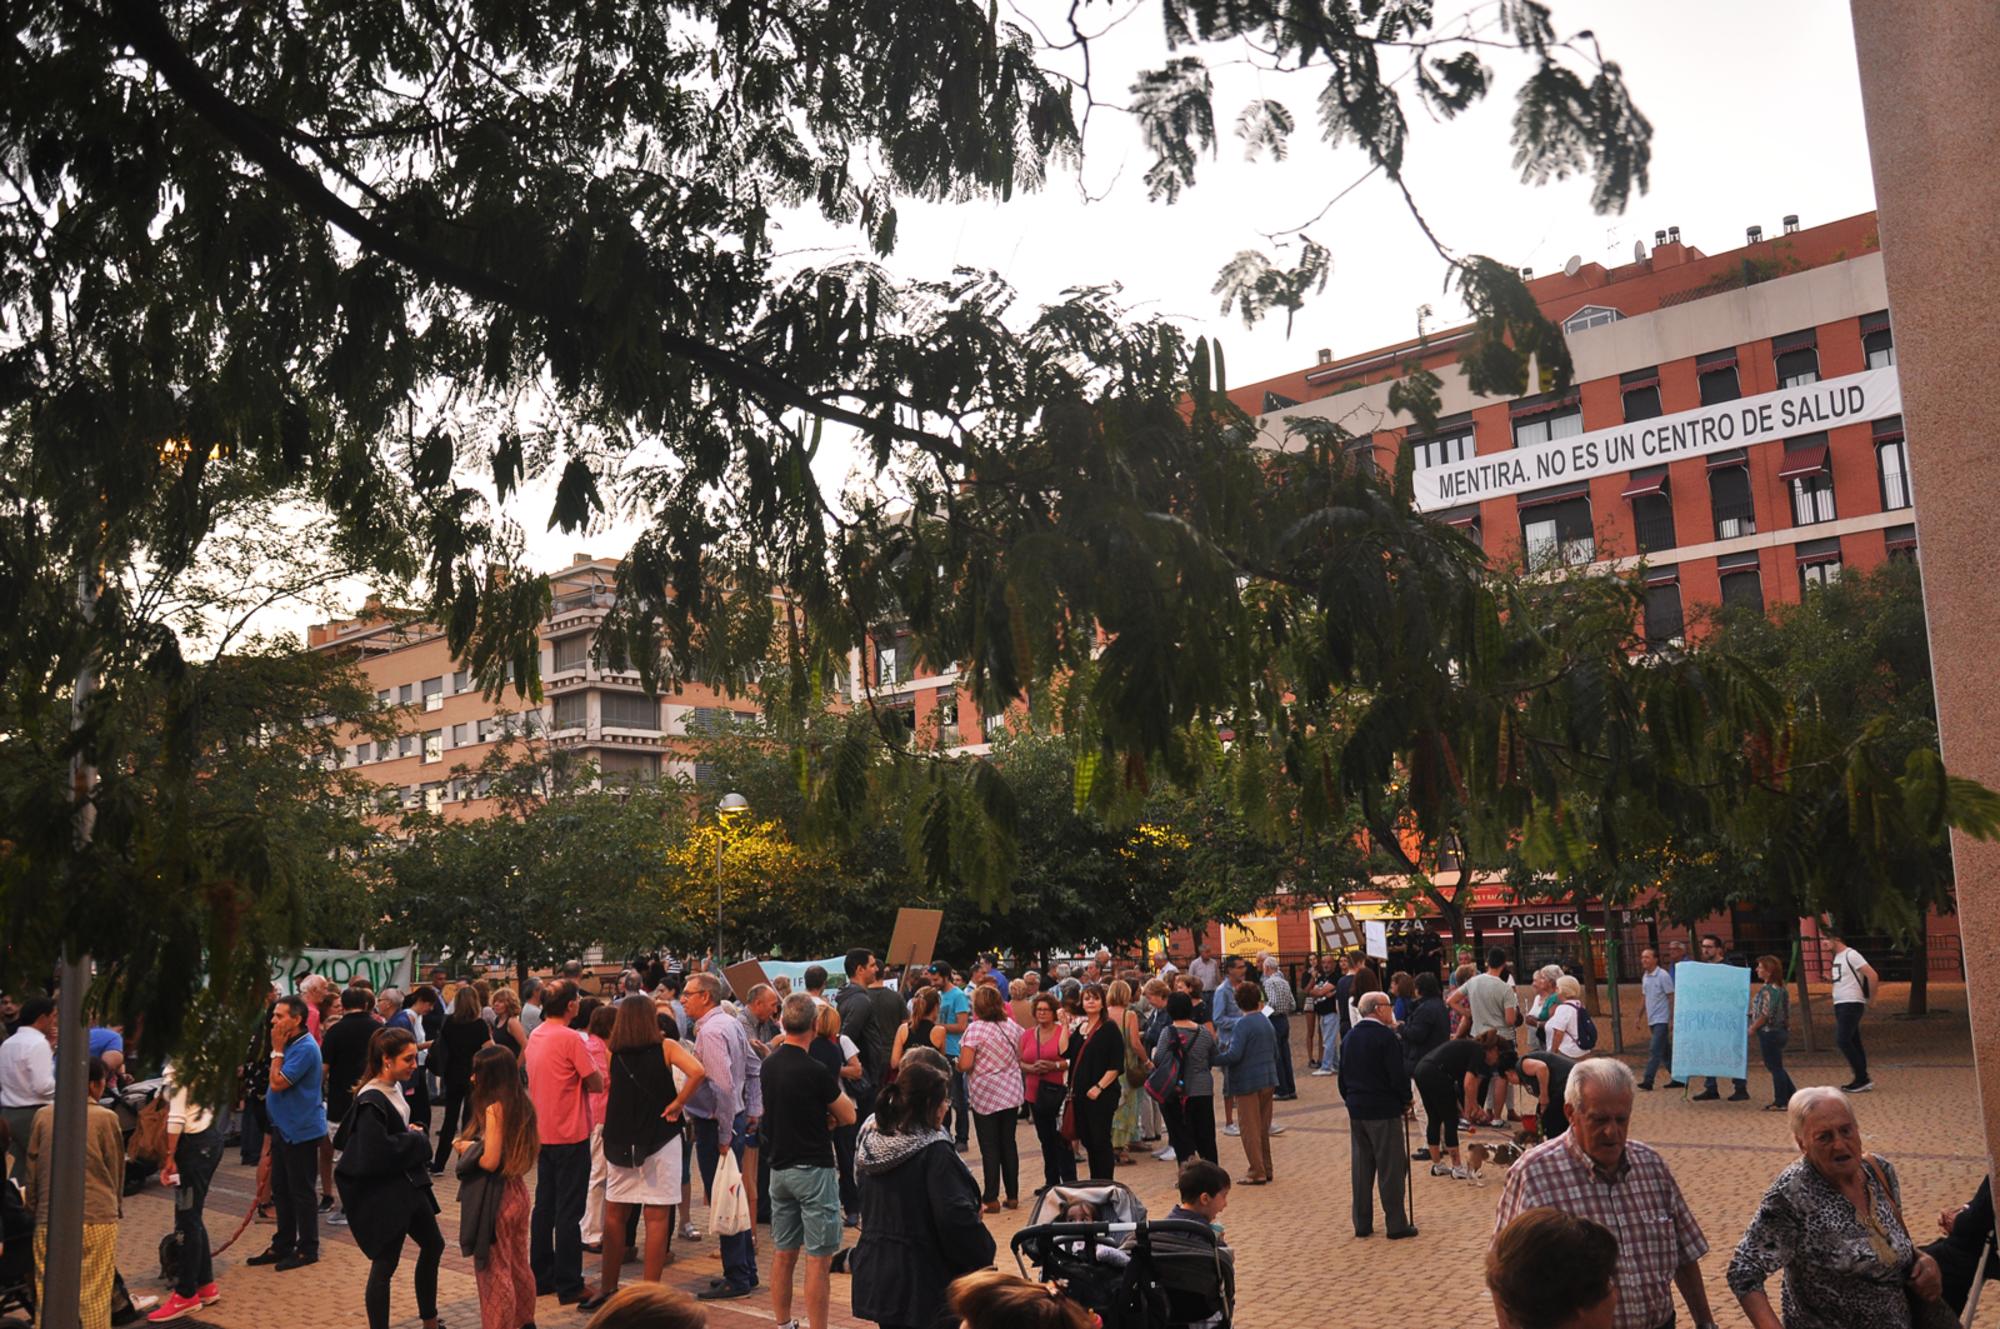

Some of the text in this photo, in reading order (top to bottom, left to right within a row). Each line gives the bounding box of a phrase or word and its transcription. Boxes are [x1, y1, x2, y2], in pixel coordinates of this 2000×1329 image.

[1439, 385, 1865, 499] MENTIRA. NO ES UN CENTRO DE SALUD
